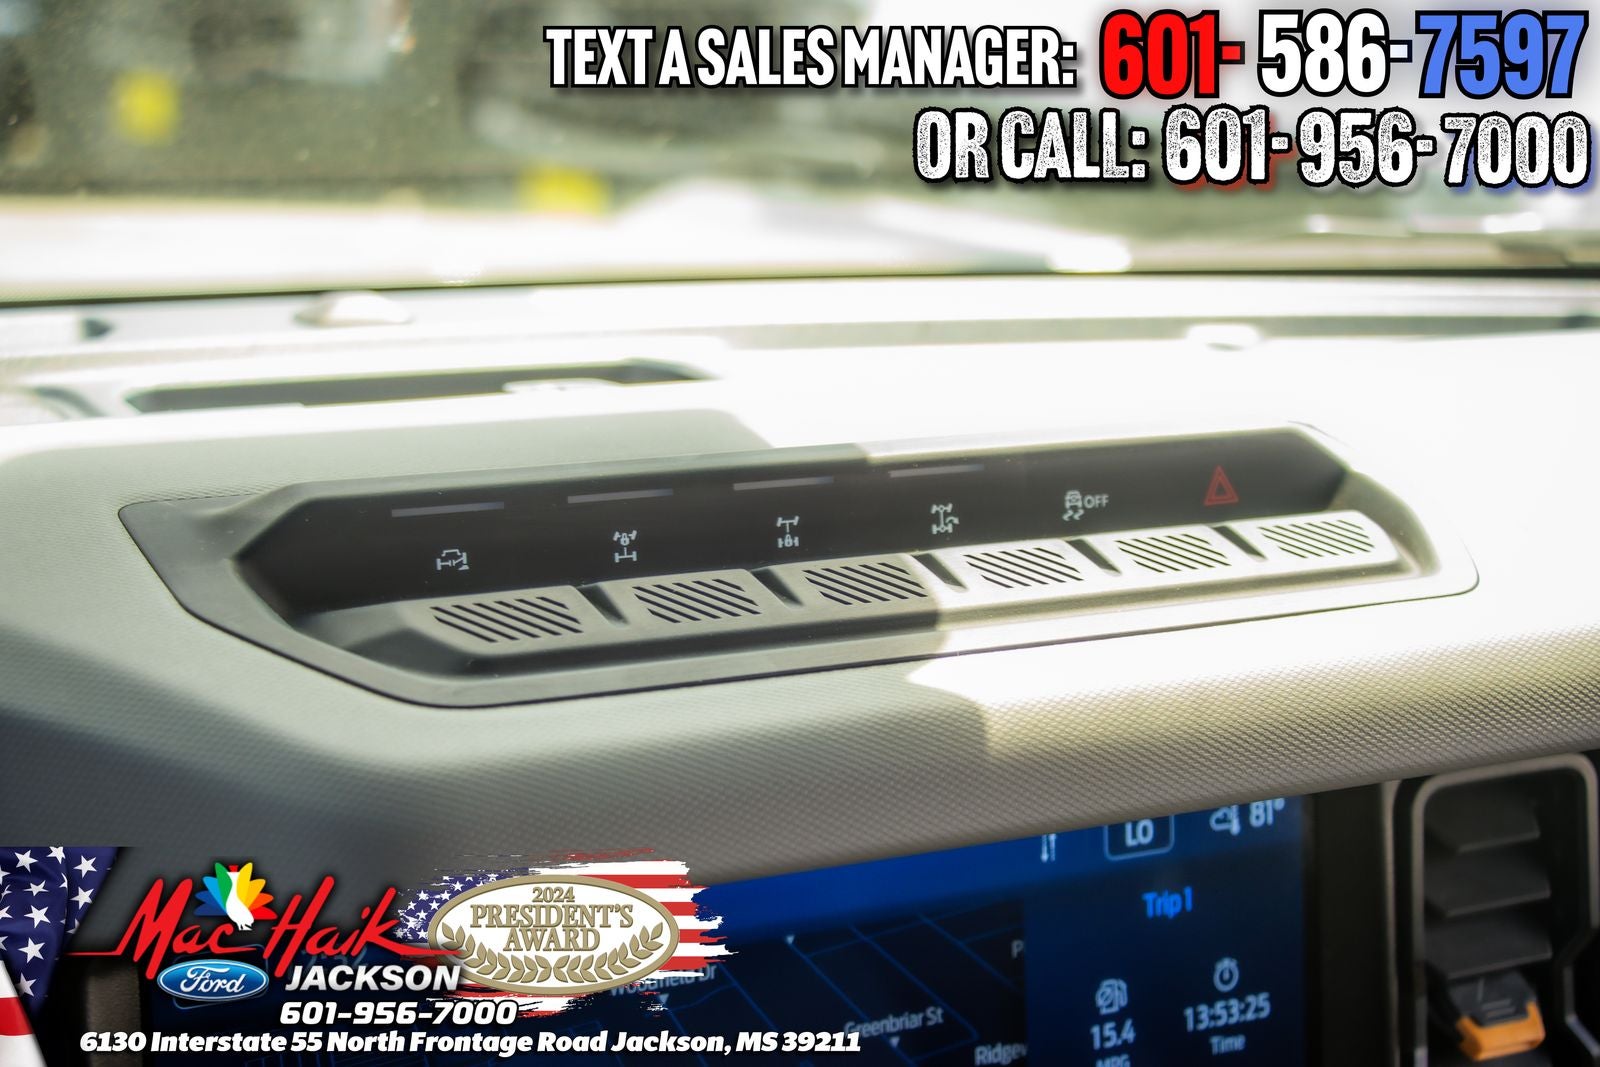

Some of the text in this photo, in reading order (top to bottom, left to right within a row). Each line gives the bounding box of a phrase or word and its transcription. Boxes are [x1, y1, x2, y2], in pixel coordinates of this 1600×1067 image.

[1083, 494, 1109, 509] OFF
[1125, 819, 1154, 847] LO
[1142, 890, 1182, 918] Trip
[925, 1006, 945, 1025] St
[1183, 992, 1271, 1032] 13:53:25
[1090, 1018, 1136, 1050] 15.4
[1209, 1034, 1246, 1055] Time
